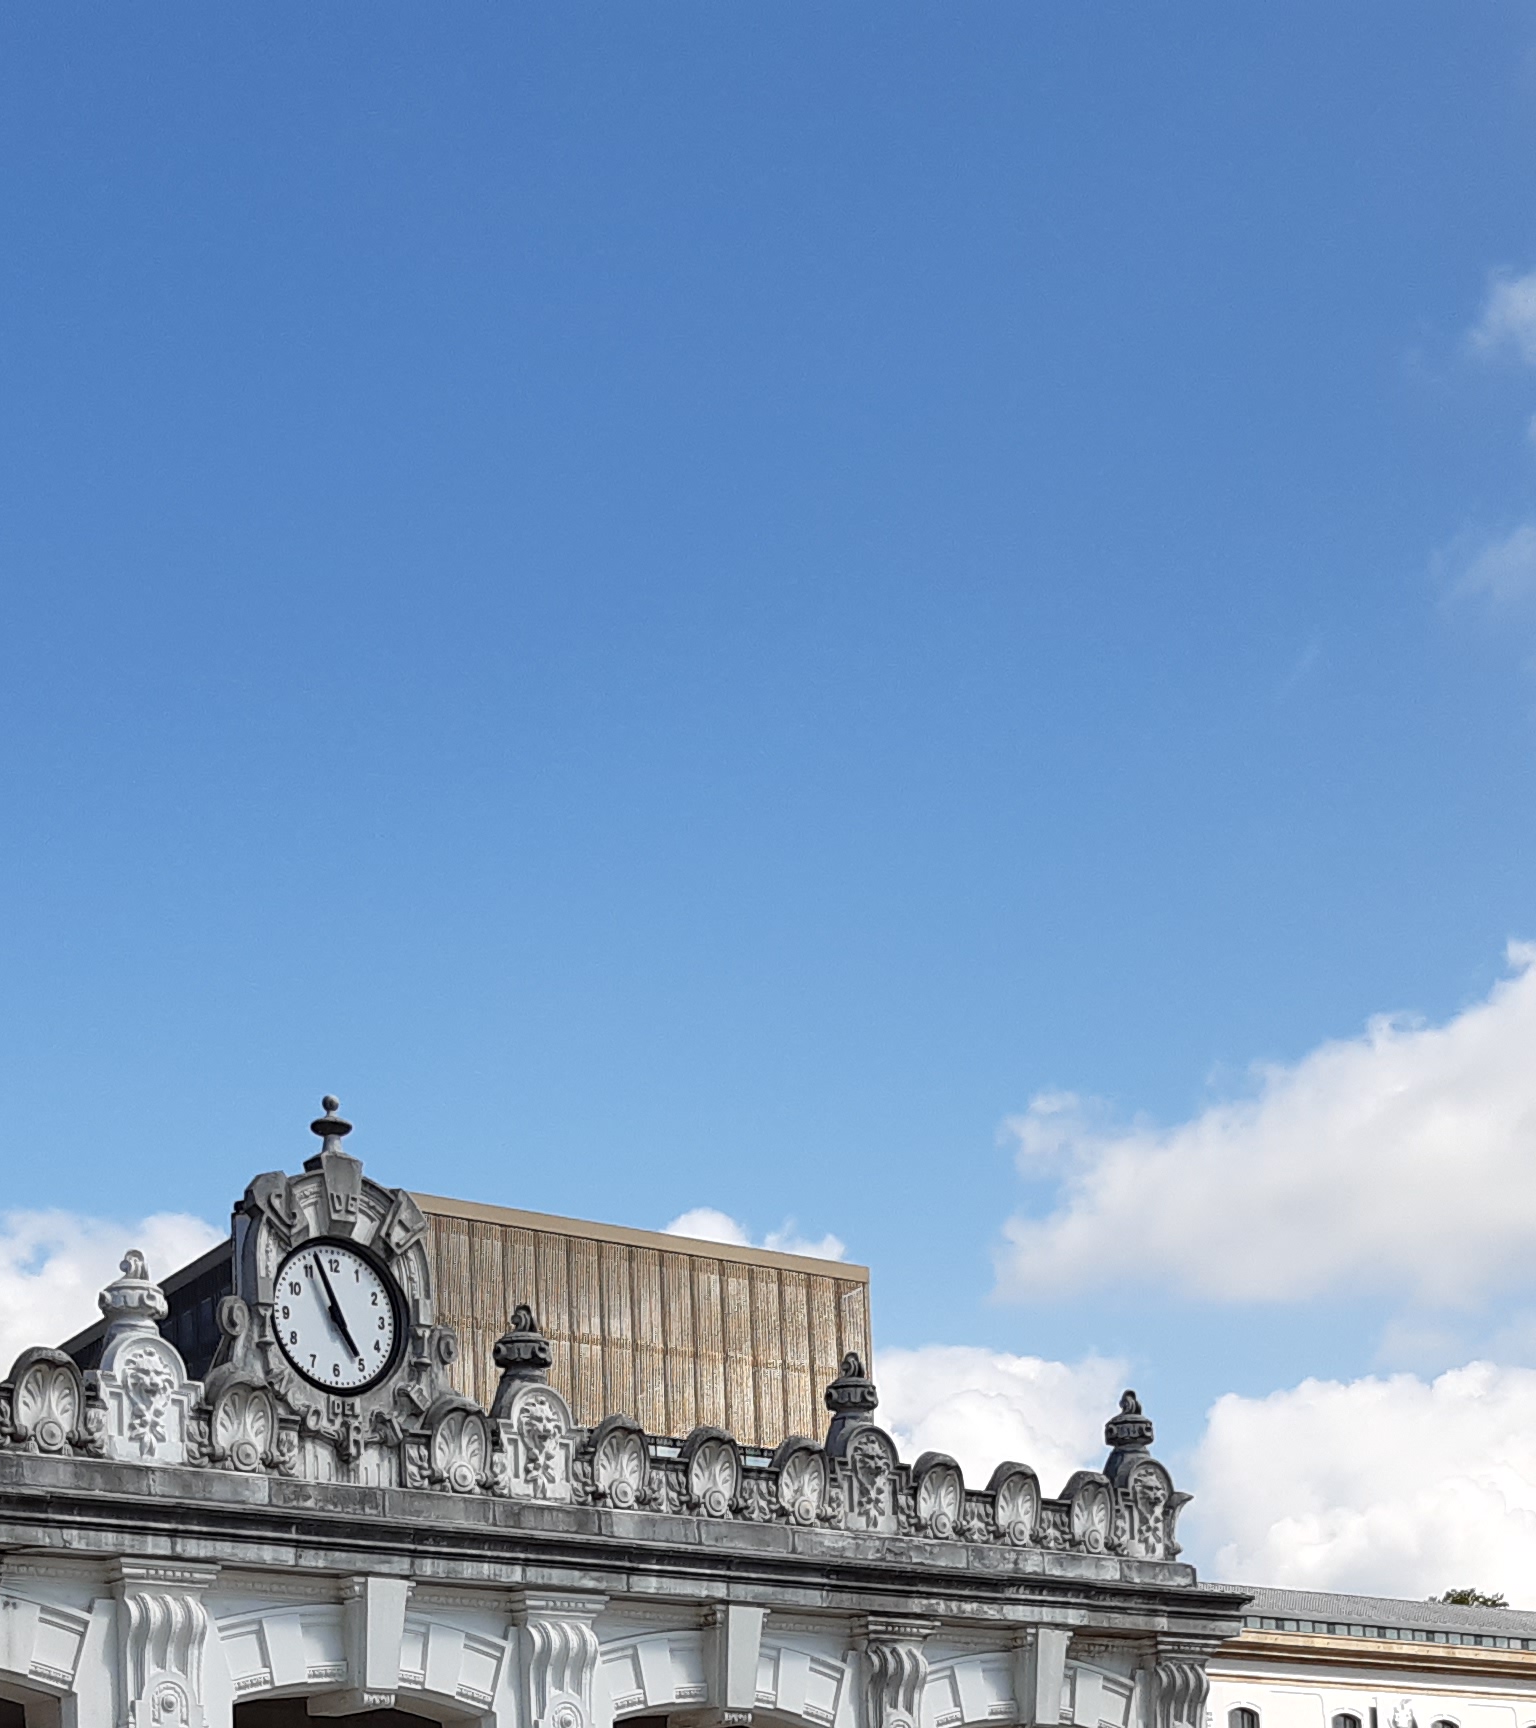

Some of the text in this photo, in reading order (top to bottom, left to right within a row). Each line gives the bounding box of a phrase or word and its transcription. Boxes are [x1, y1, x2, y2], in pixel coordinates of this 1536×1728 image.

[330, 1192, 359, 1216] DE
[304, 1264, 313, 1279] 11
[328, 1259, 340, 1273] 12
[354, 1269, 359, 1283] 1
[288, 1281, 301, 1296] 10
[371, 1292, 378, 1306] 2
[282, 1306, 290, 1319] 9
[378, 1316, 385, 1330] 3
[290, 1331, 298, 1345] 8
[373, 1339, 381, 1353] 4
[309, 1354, 316, 1368] 7
[358, 1358, 365, 1372] 5
[332, 1363, 340, 1377] 6
